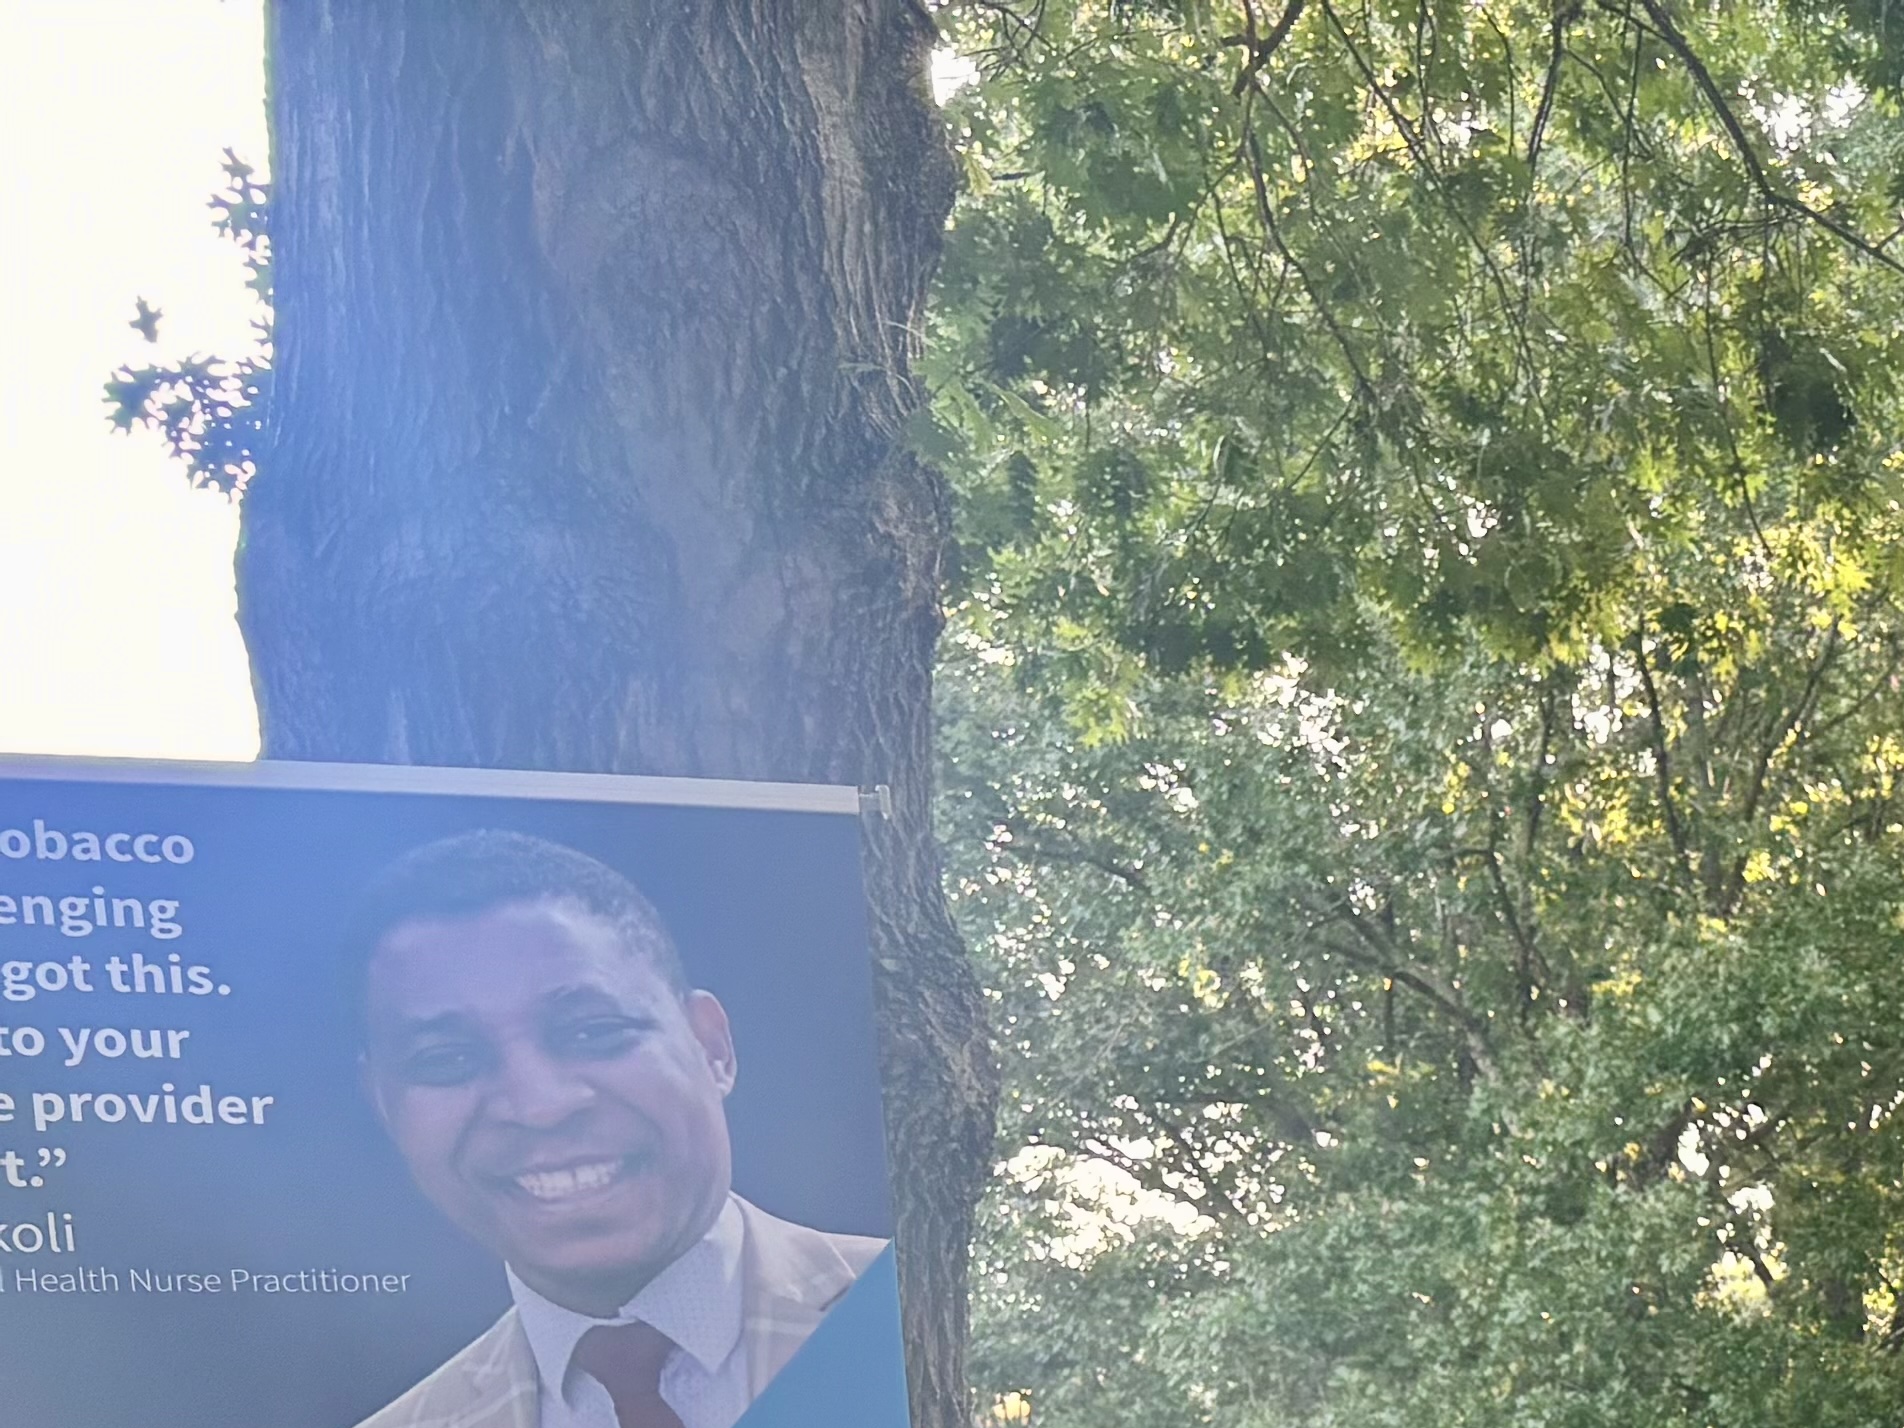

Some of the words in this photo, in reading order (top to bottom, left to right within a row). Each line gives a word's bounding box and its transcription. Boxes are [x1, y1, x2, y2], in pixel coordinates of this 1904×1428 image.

[2, 955, 93, 1001] got
[106, 953, 232, 996] this.
[58, 1025, 190, 1066] your
[32, 1083, 274, 1131] provider
[15, 1267, 119, 1292] Health
[130, 1268, 221, 1292] Nurse
[231, 1267, 410, 1294] Practitioner
